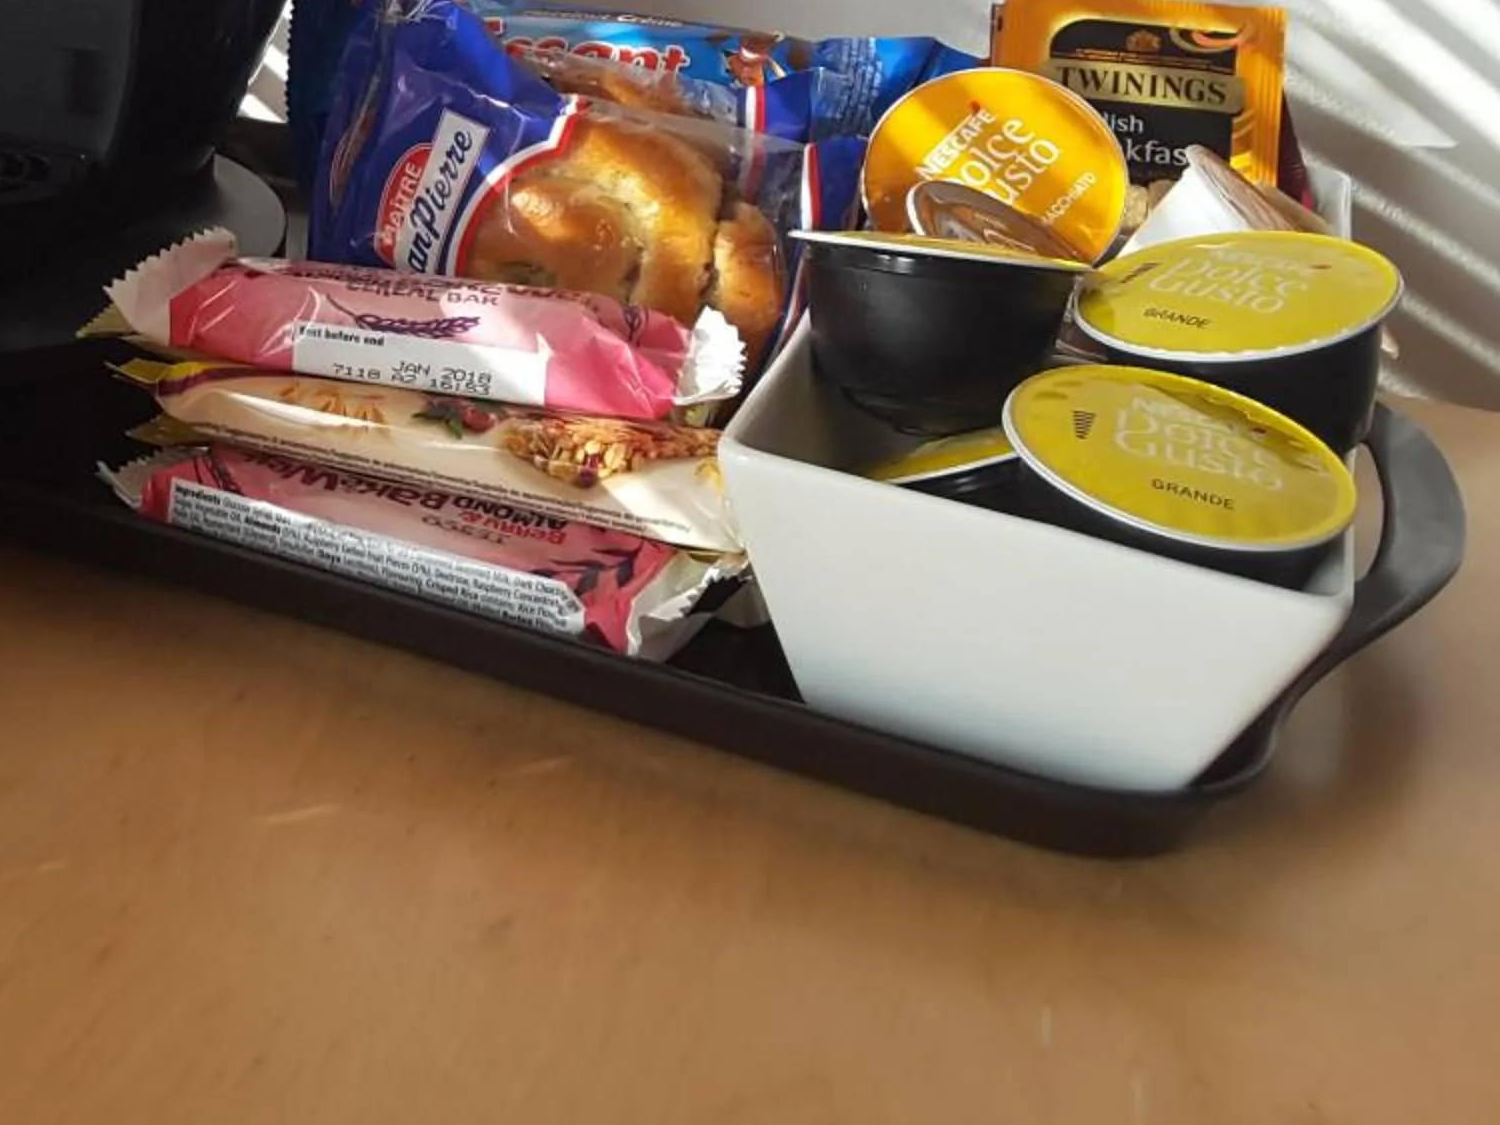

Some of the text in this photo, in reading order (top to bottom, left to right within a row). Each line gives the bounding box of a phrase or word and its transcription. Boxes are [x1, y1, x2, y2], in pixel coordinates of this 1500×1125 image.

[1056, 65, 1228, 106] TWININGS
[960, 118, 1036, 187] olce
[996, 139, 1061, 204] usto
[1143, 306, 1211, 329] GRANDE
[363, 334, 385, 347] end
[391, 359, 431, 376] JAN
[1152, 478, 1236, 510] GRANDE
